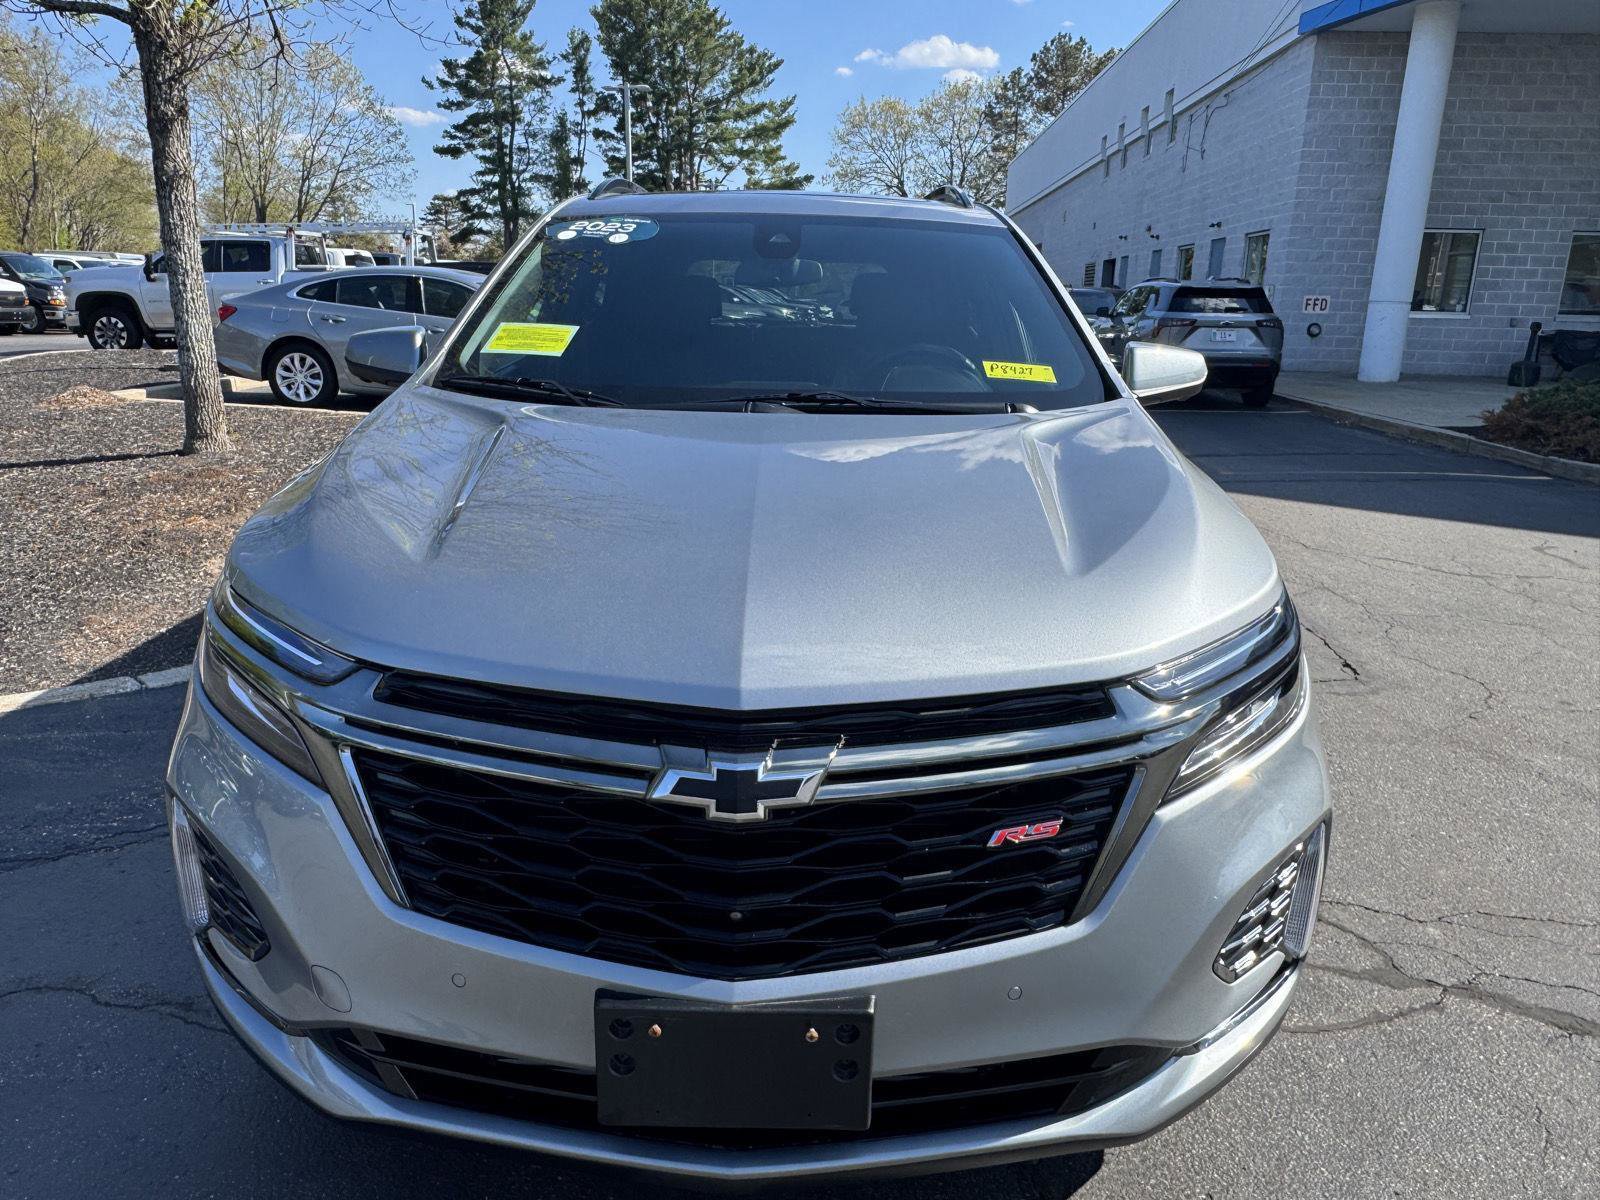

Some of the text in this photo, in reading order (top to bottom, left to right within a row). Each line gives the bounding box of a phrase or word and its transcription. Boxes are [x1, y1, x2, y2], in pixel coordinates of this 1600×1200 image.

[568, 220, 637, 233] 2023
[1304, 297, 1328, 311] FFD
[989, 362, 1034, 376] P8427
[986, 817, 1064, 847] RS
